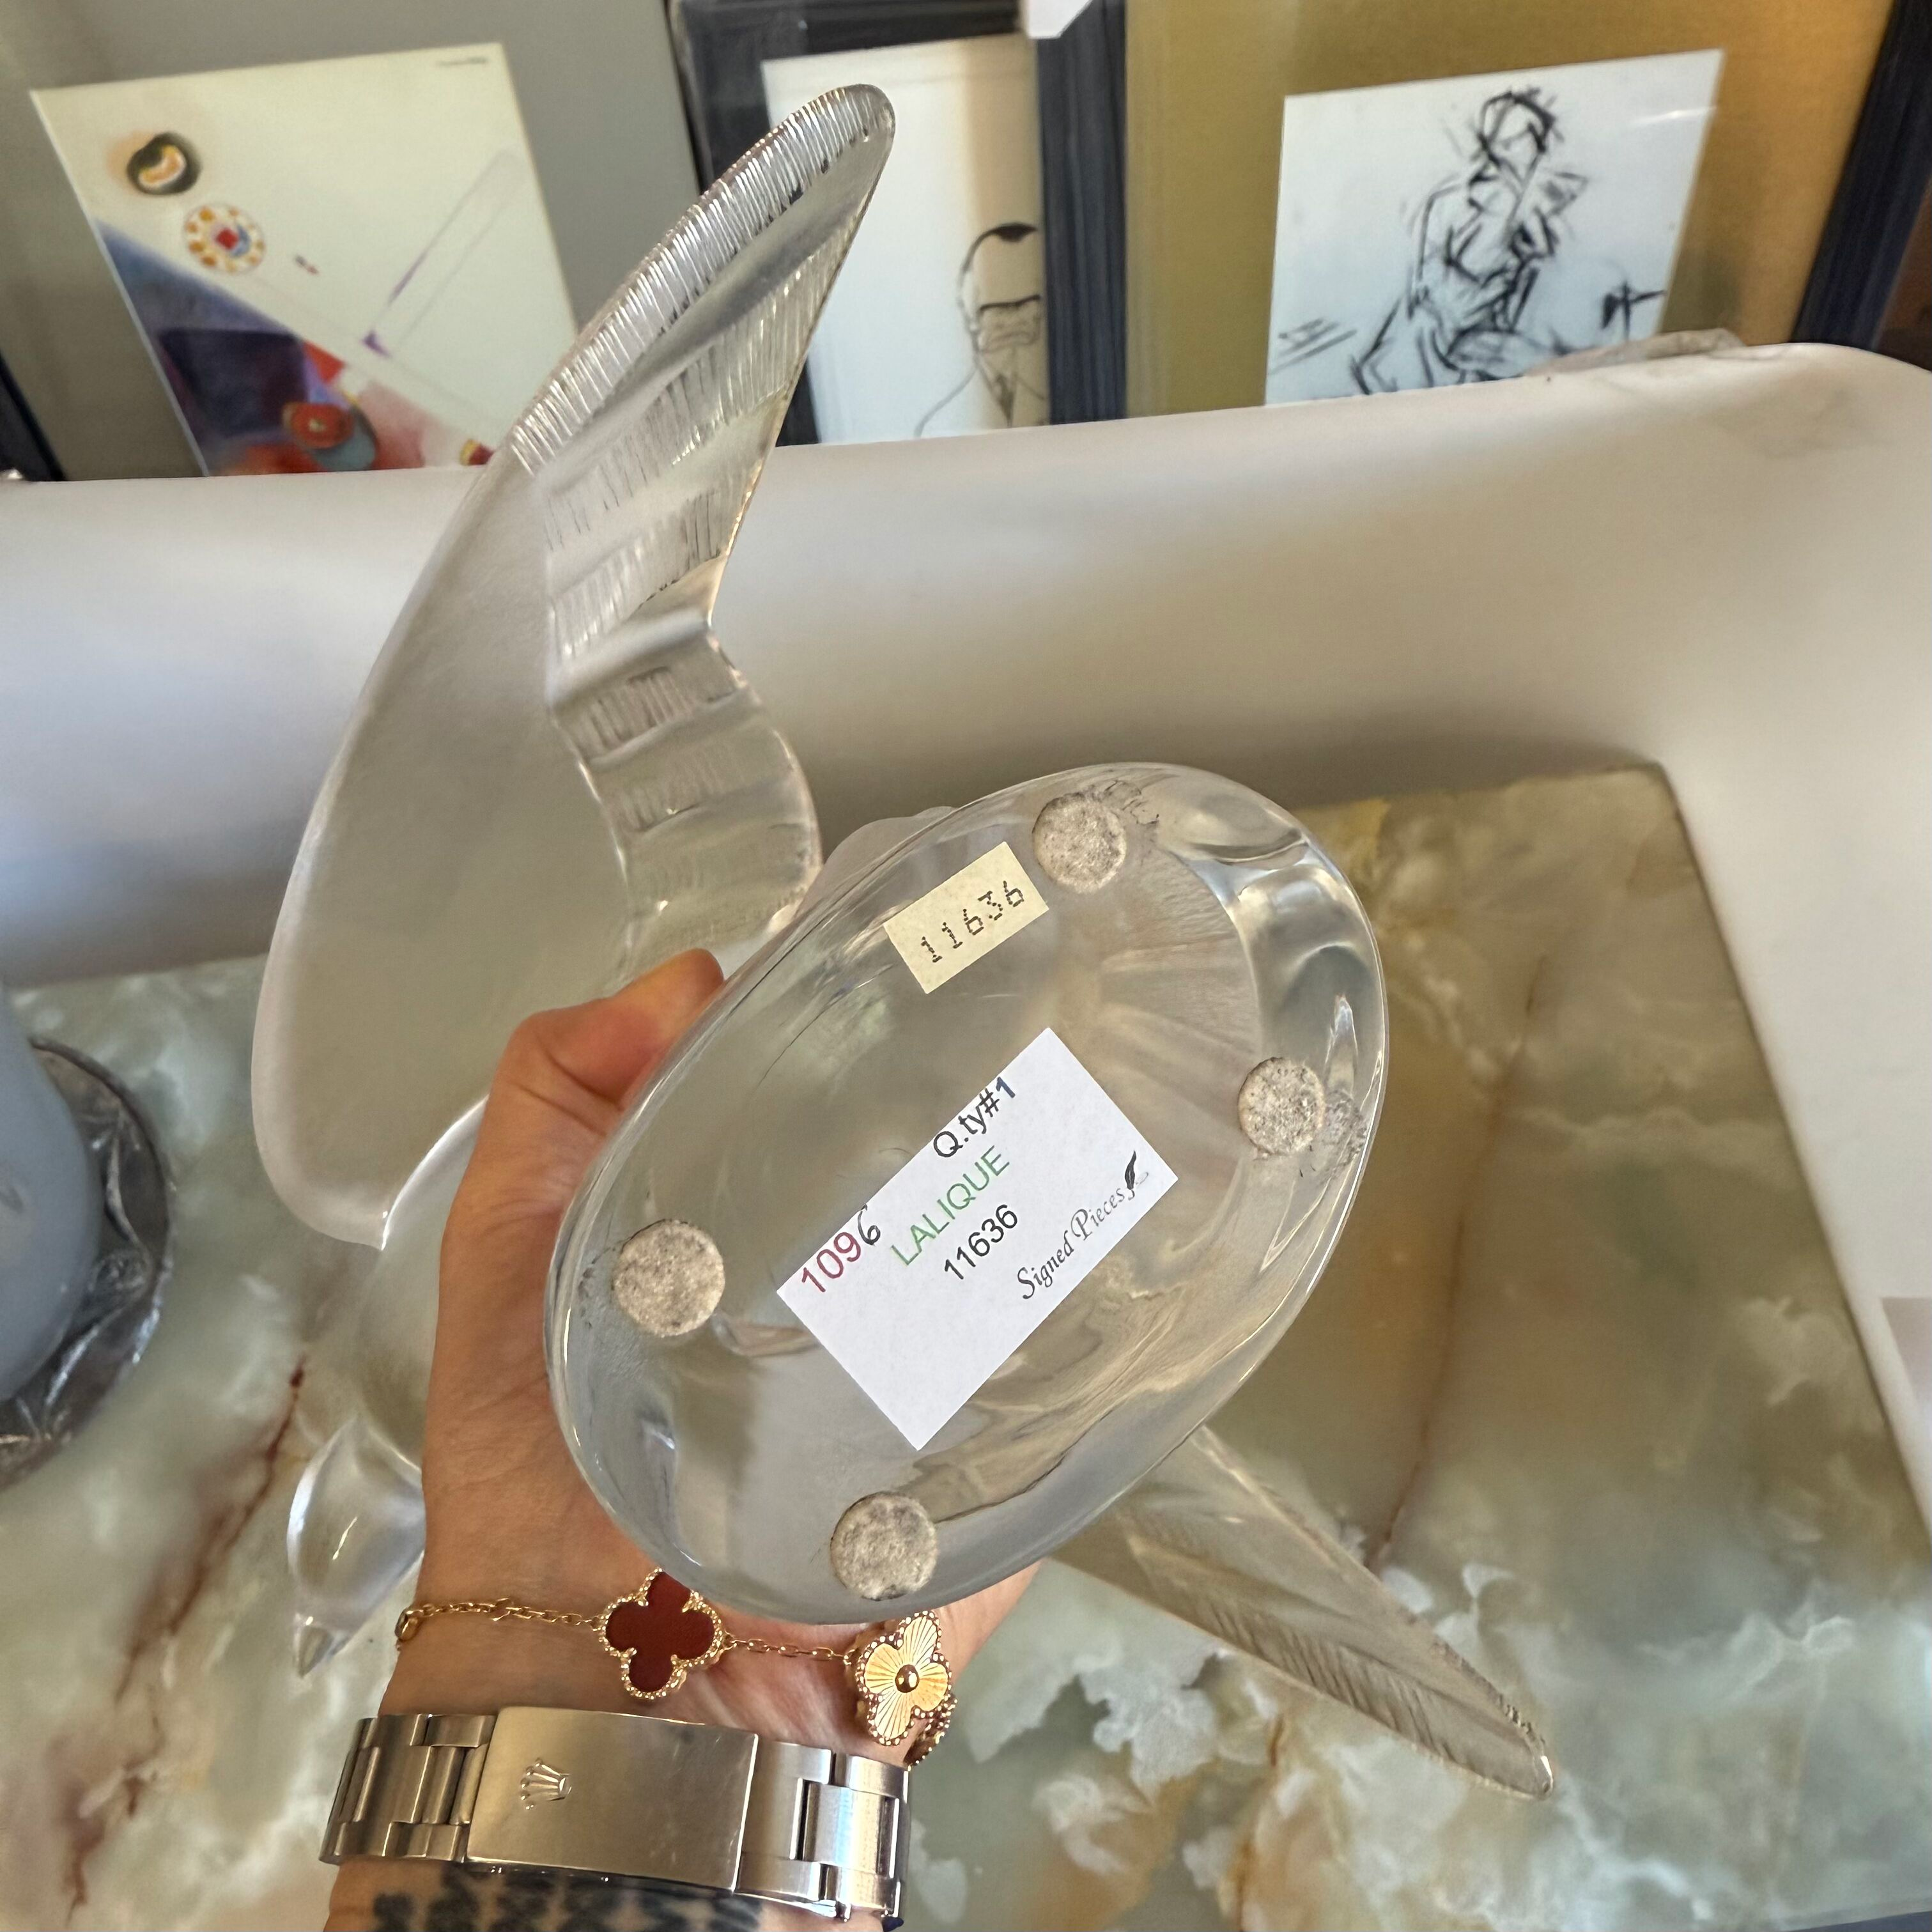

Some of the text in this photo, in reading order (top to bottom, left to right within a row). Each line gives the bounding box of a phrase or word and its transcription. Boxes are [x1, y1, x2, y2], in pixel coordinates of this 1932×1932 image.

[921, 880, 1024, 963] 11636
[801, 1205, 881, 1292] 1096
[891, 1145, 1010, 1266] LALIQUE
[943, 1204, 1018, 1280] 11636
[1017, 1187, 1125, 1300] Signed Pieces
